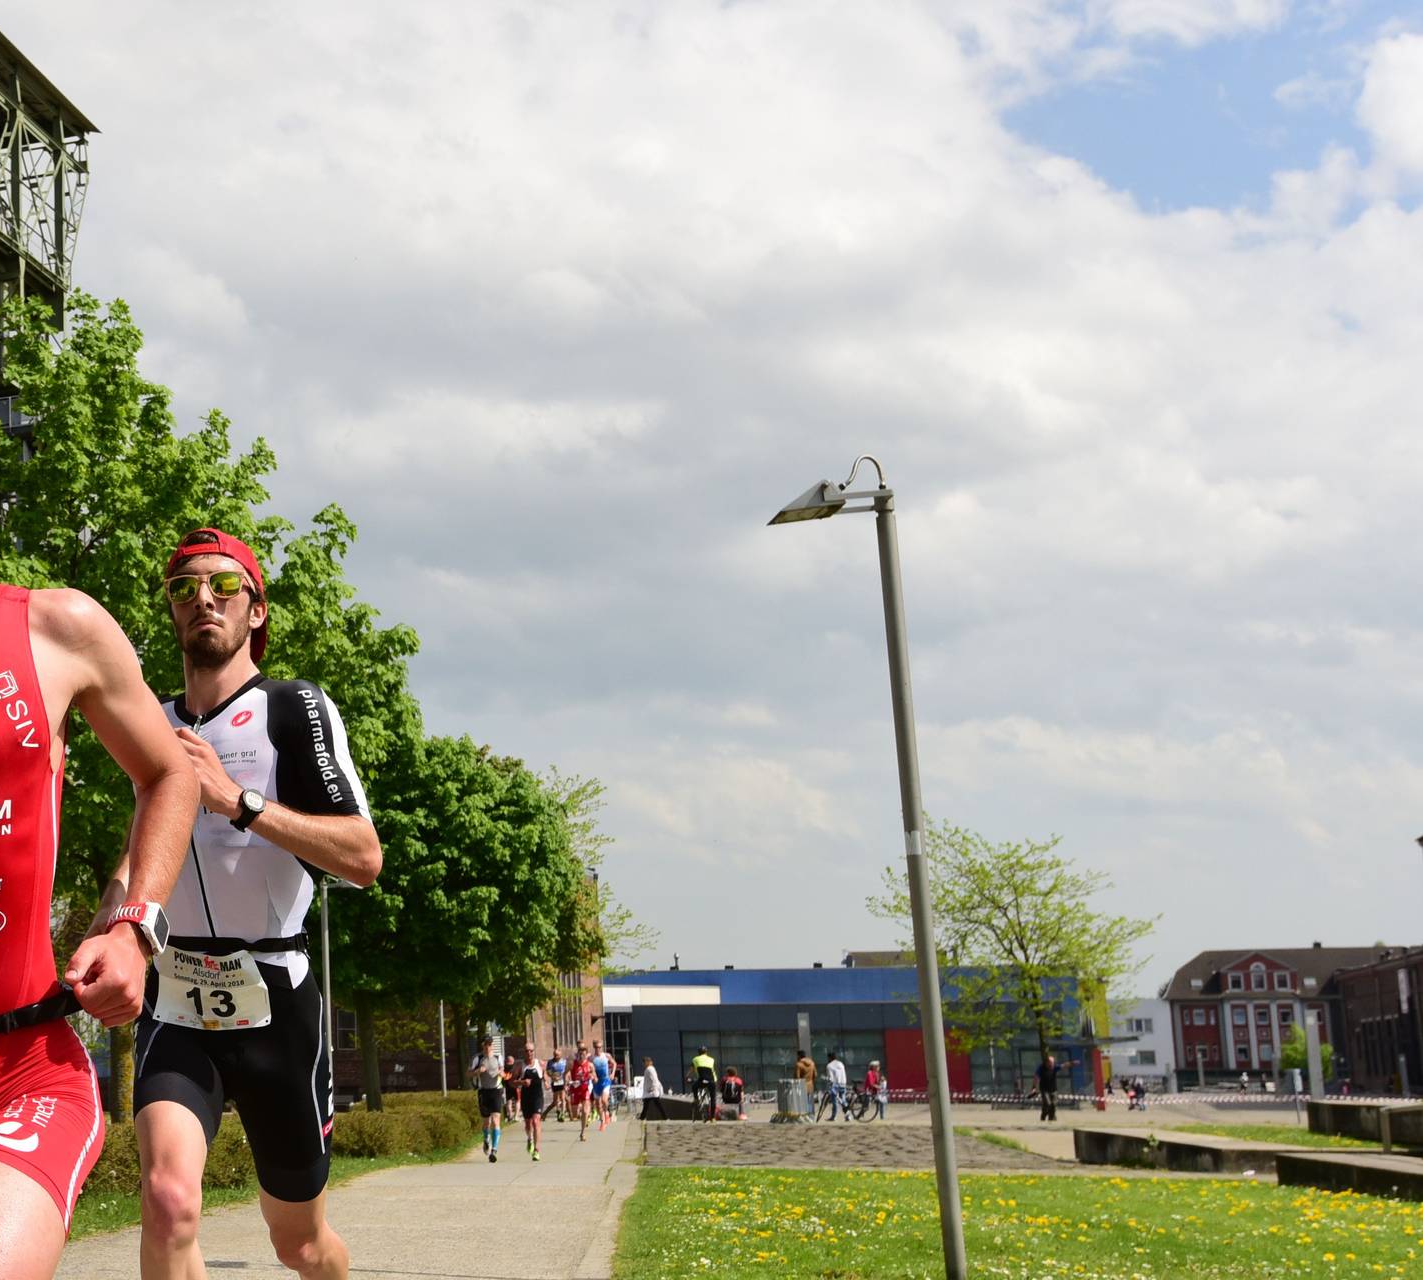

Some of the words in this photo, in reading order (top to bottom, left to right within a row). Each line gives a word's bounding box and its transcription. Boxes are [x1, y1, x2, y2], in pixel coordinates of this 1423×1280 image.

[6, 700, 40, 748] SIV
[241, 750, 257, 758] graf
[297, 689, 343, 804] pharmafold.eu
[174, 951, 203, 967] POWER
[220, 958, 242, 972] MAN
[193, 968, 220, 979] Alsdorf
[211, 980, 226, 988] April
[186, 987, 236, 1017] 13
